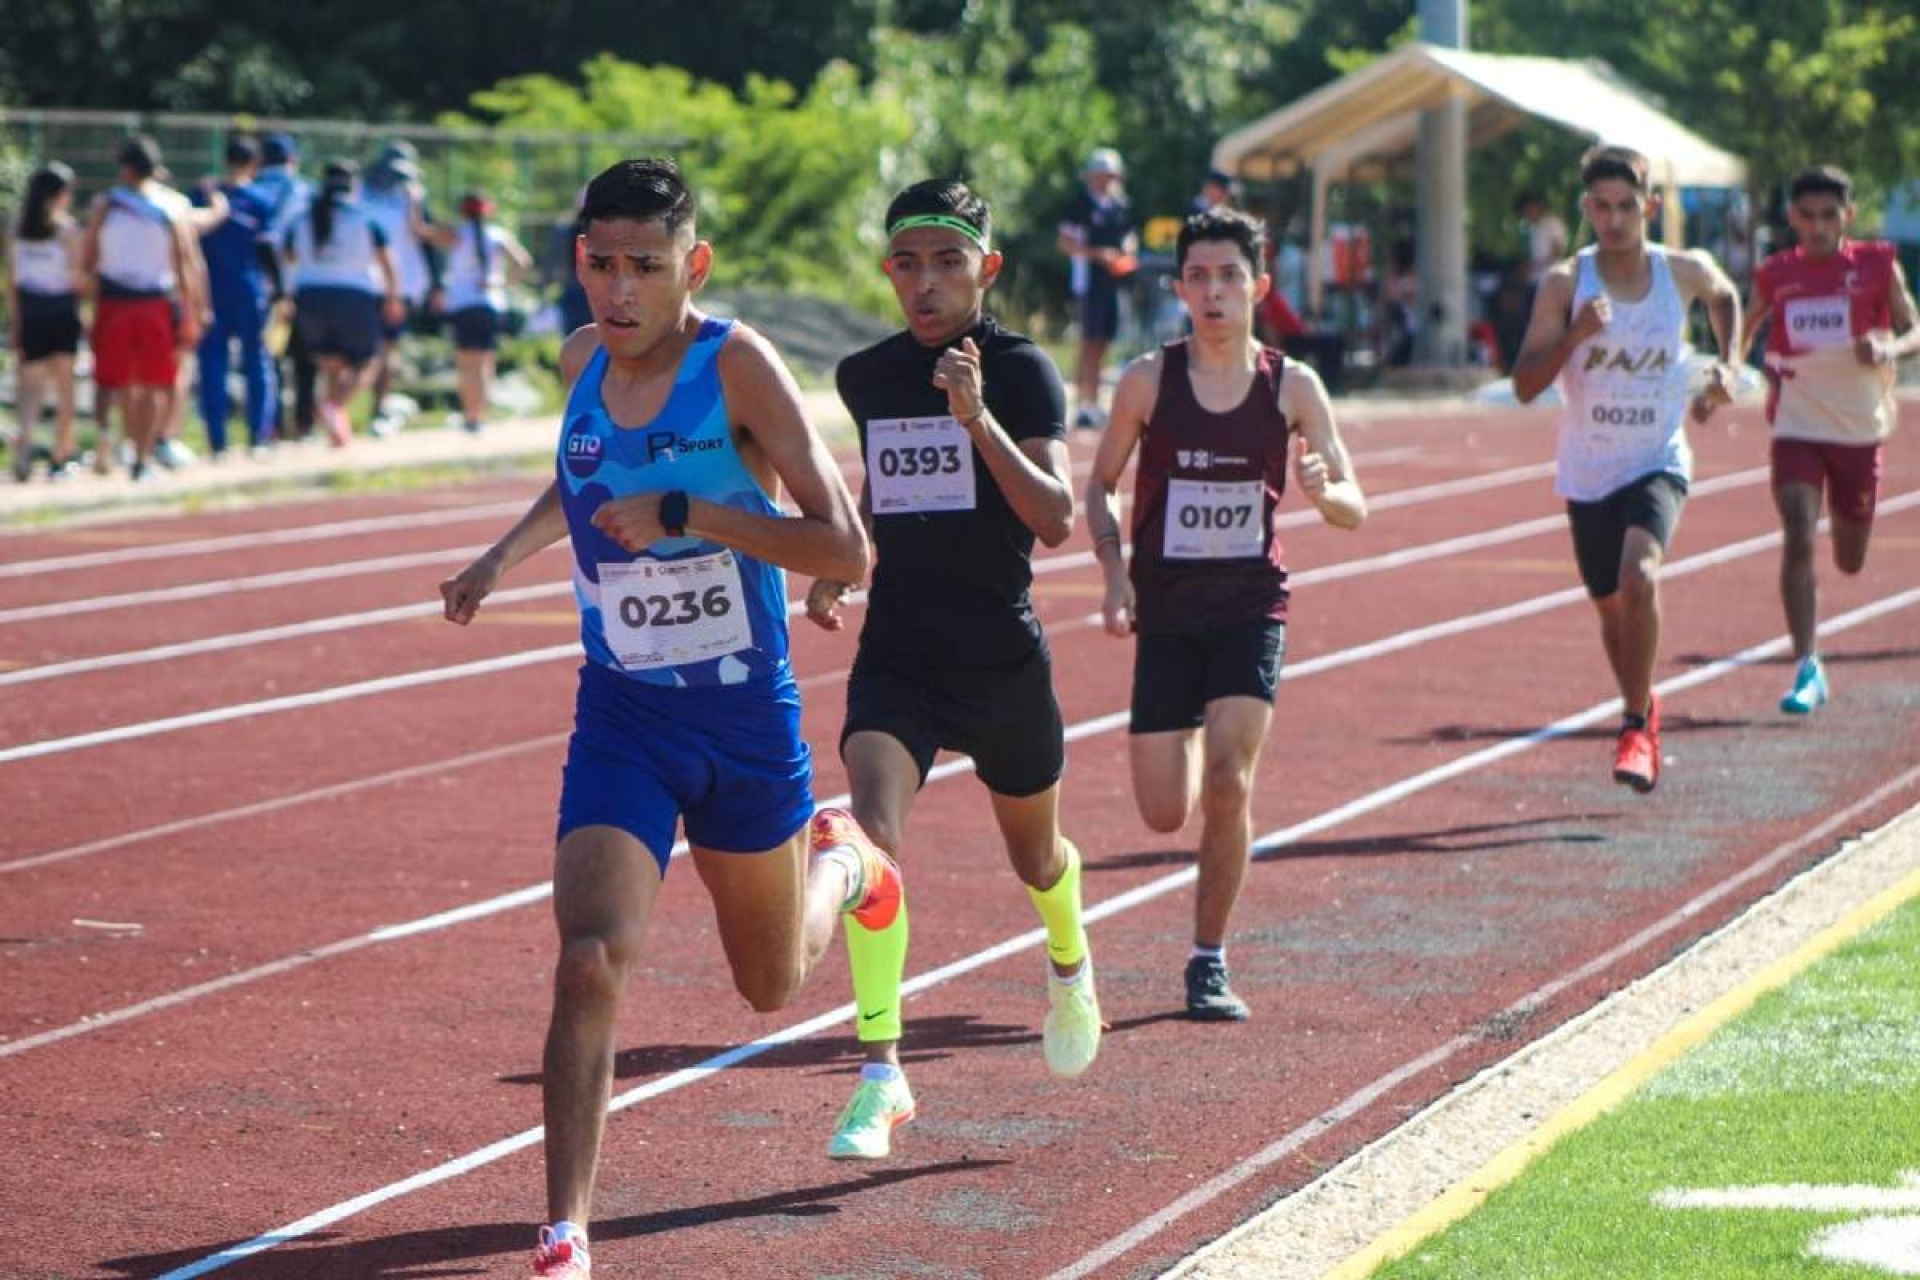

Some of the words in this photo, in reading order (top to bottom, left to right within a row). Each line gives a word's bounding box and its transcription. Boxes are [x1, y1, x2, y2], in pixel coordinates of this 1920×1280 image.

[1591, 404, 1656, 426] 0028
[568, 433, 601, 452] GTO
[879, 444, 962, 477] 0393
[1178, 504, 1253, 529] 0107
[619, 585, 731, 629] 0236
